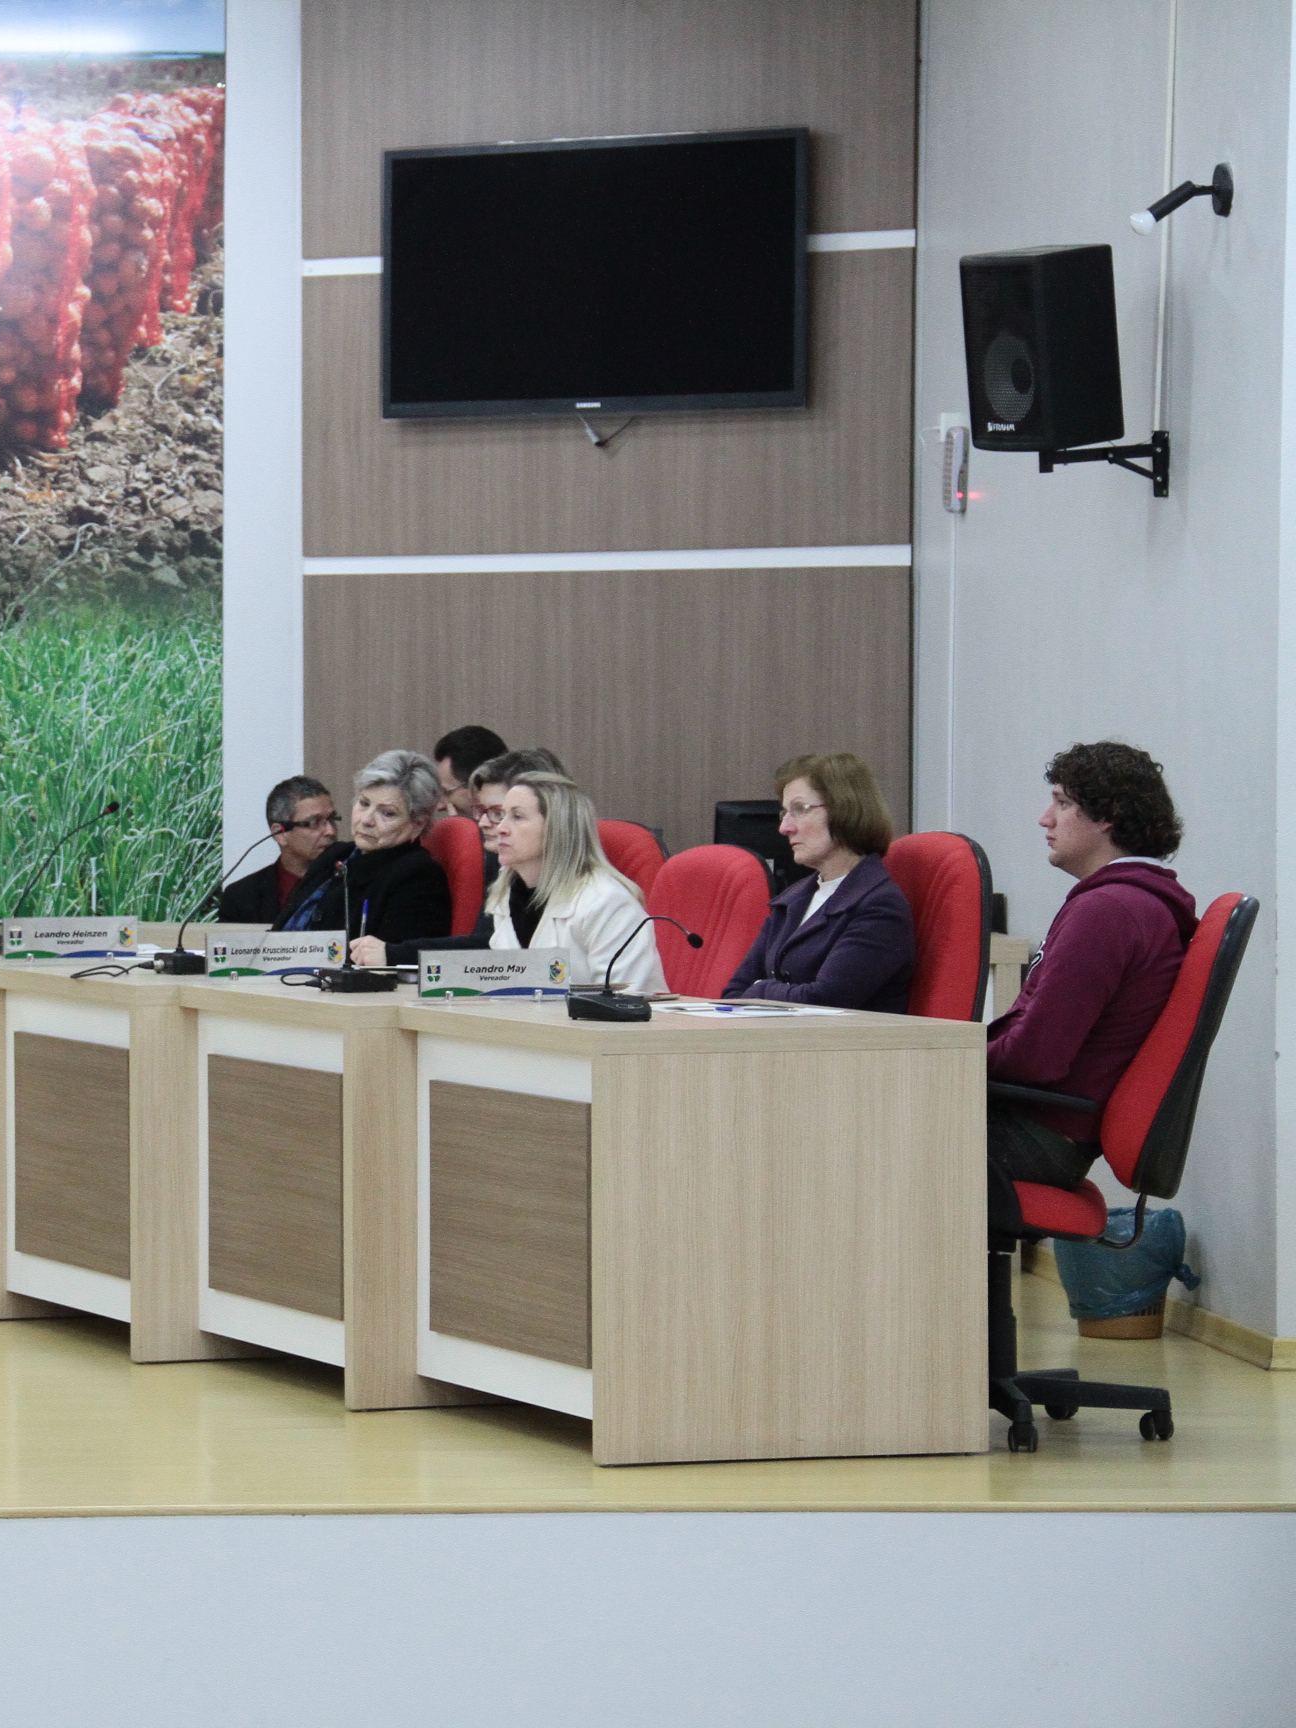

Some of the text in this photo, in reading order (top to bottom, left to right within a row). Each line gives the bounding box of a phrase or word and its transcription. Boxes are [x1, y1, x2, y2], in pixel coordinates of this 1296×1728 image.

[34, 930, 108, 939] Leandro Heinzen
[230, 946, 261, 955] Leonardo
[299, 945, 308, 953] da
[309, 944, 324, 953] Silva
[464, 964, 527, 974] Leandro May
